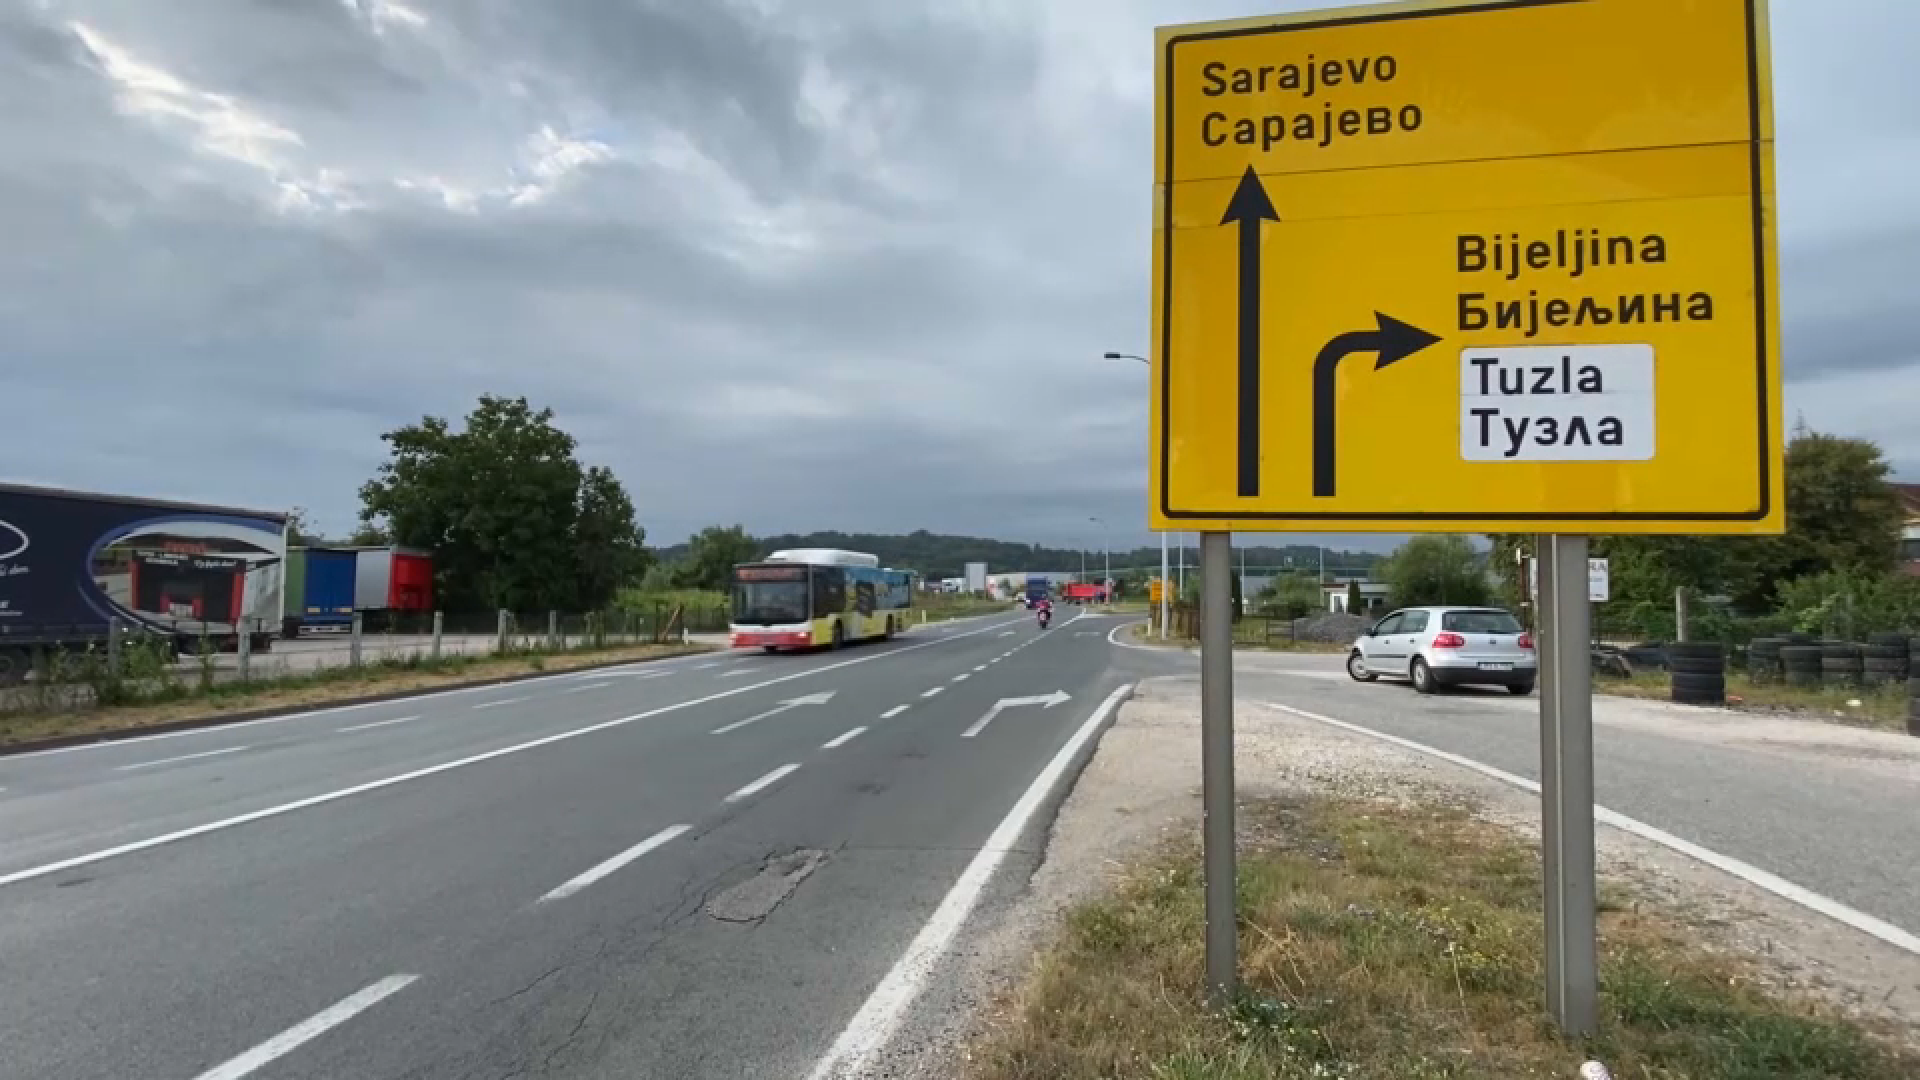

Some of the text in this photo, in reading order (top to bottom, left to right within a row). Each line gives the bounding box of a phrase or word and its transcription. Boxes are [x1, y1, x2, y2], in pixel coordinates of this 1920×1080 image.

[1201, 53, 1397, 97] Sarajevo
[1201, 102, 1423, 153] Сарајево
[1457, 228, 1667, 281] Bijeljina
[1457, 289, 1713, 338] Бијељина
[1470, 356, 1603, 396] Tuzla
[1470, 408, 1623, 457] Тузла
